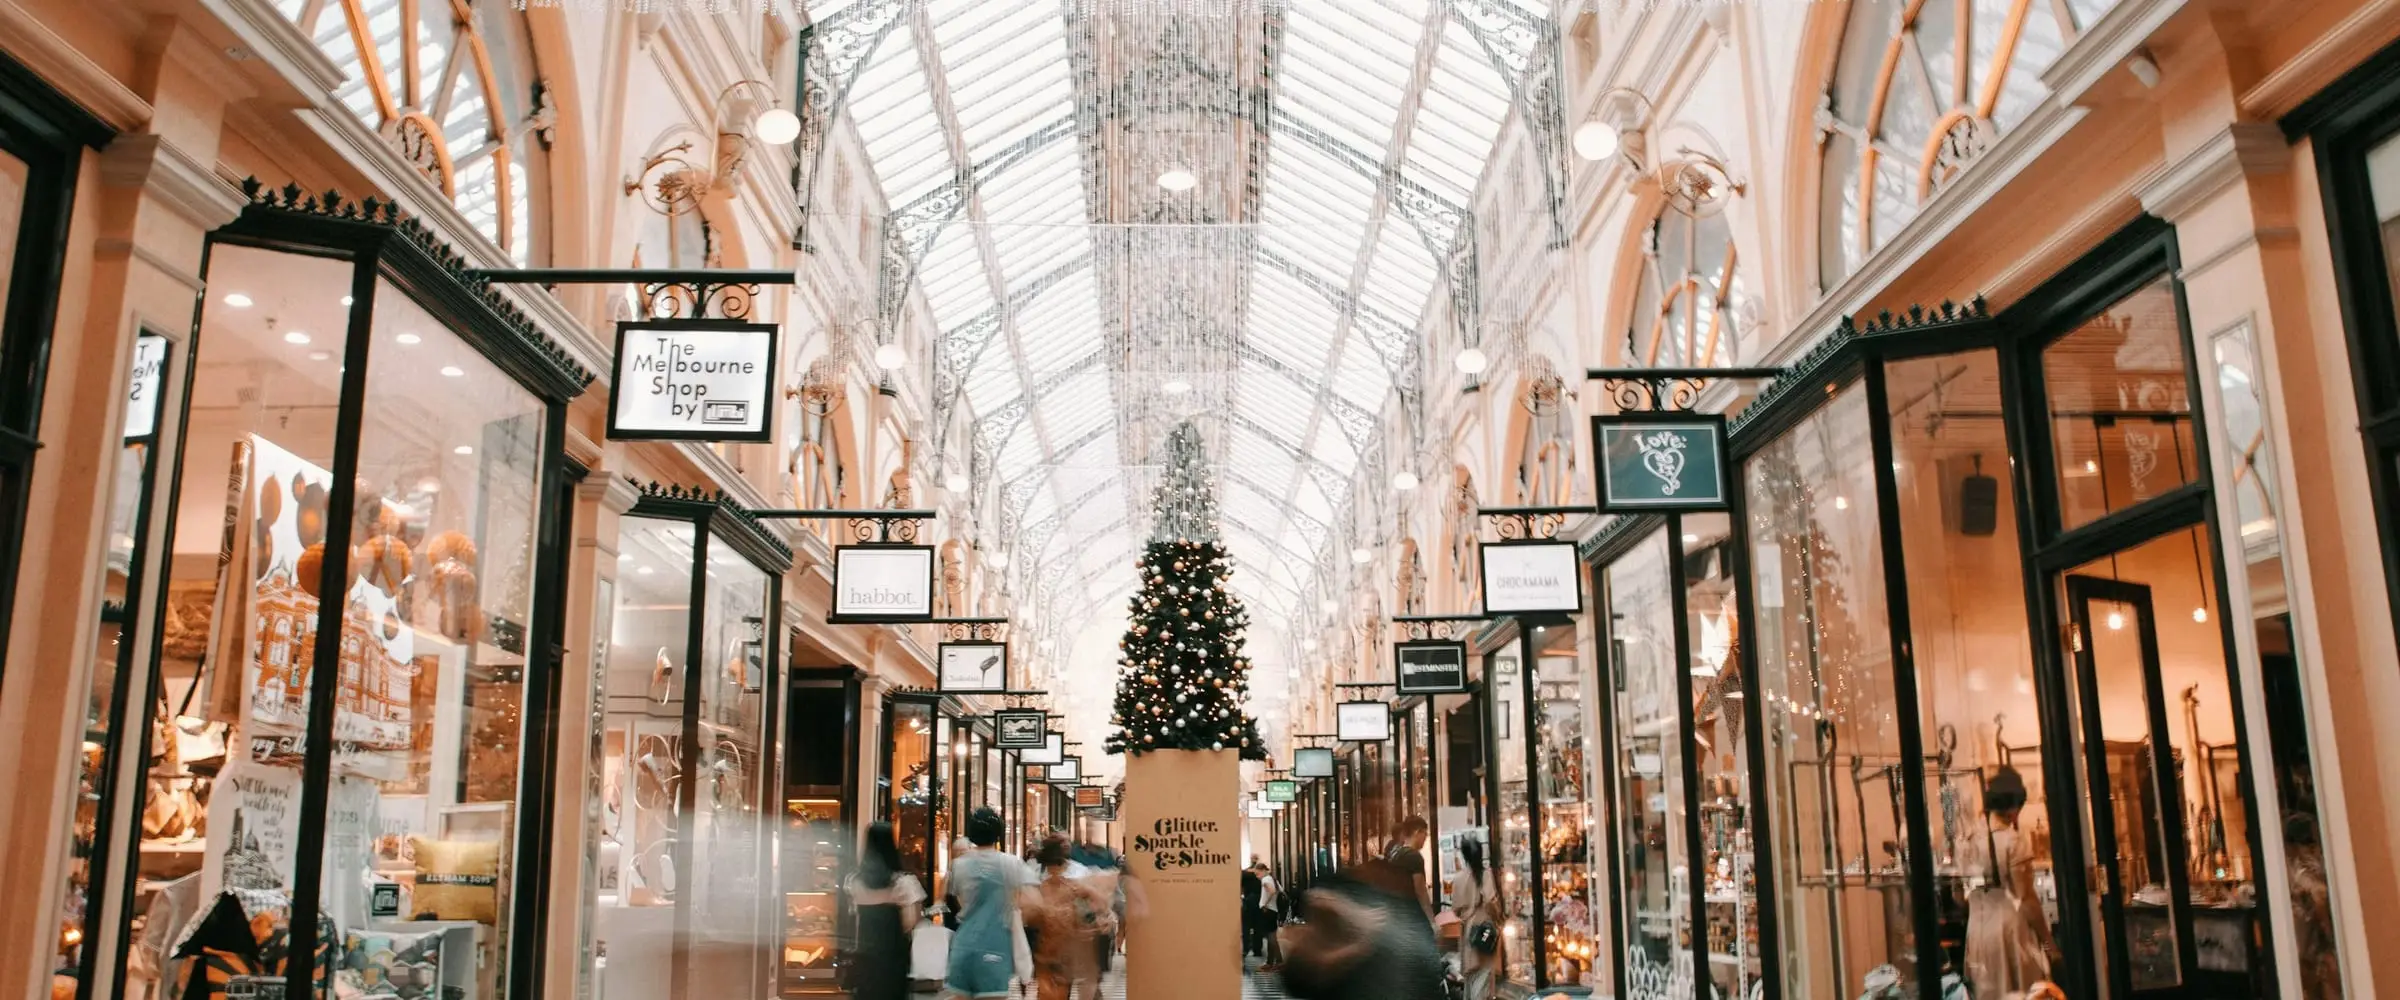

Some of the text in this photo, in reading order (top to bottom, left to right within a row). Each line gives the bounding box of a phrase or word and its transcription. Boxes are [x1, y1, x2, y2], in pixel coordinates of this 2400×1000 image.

[657, 337, 695, 359] The
[633, 354, 754, 374] Melbourne
[651, 376, 707, 400] Shop
[671, 402, 698, 421] by
[1154, 817, 1218, 836] Glitter.
[1134, 834, 1204, 852] Sparkle
